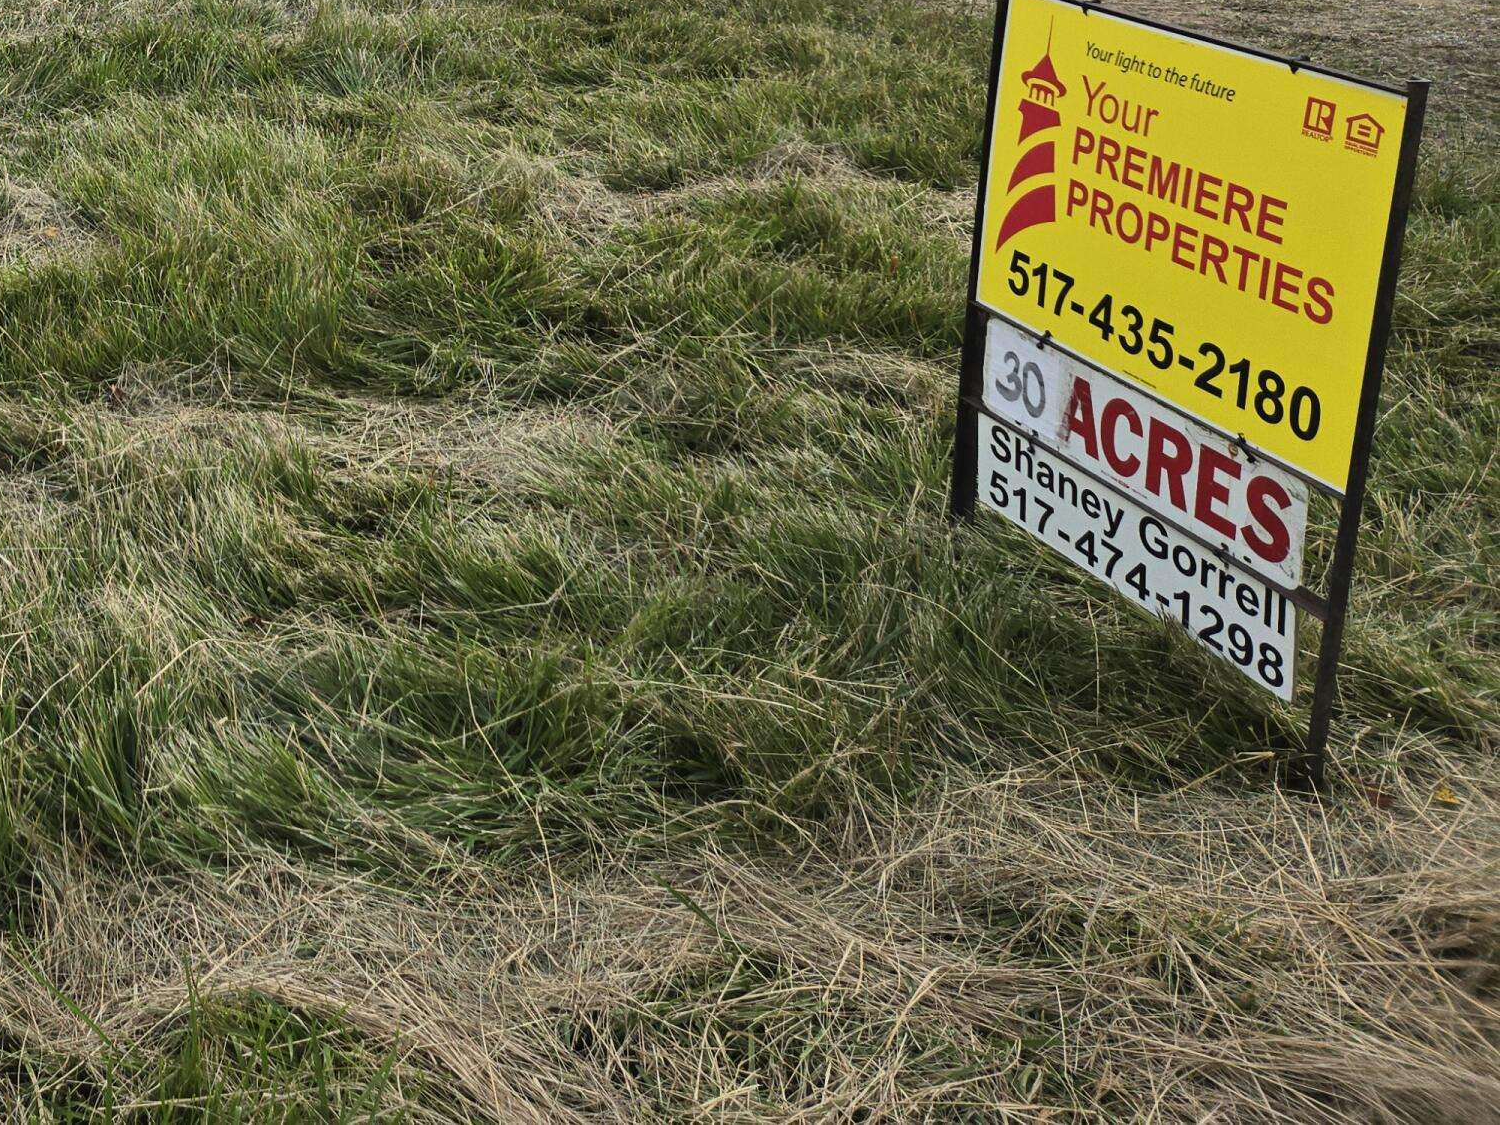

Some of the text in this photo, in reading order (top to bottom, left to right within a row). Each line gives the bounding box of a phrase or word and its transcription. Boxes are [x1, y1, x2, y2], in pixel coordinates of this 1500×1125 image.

[1081, 74, 1160, 137] Your
[1086, 41, 1236, 102] Your light to the future
[1066, 179, 1335, 325] PROPERTIES
[1072, 126, 1288, 245] PREMIERE
[1007, 249, 1322, 442] 517-435-2180
[990, 425, 1286, 637] Shaney Gorrell
[995, 350, 1289, 562] 30 ACRES
[989, 469, 1285, 688] 517-474-1298
